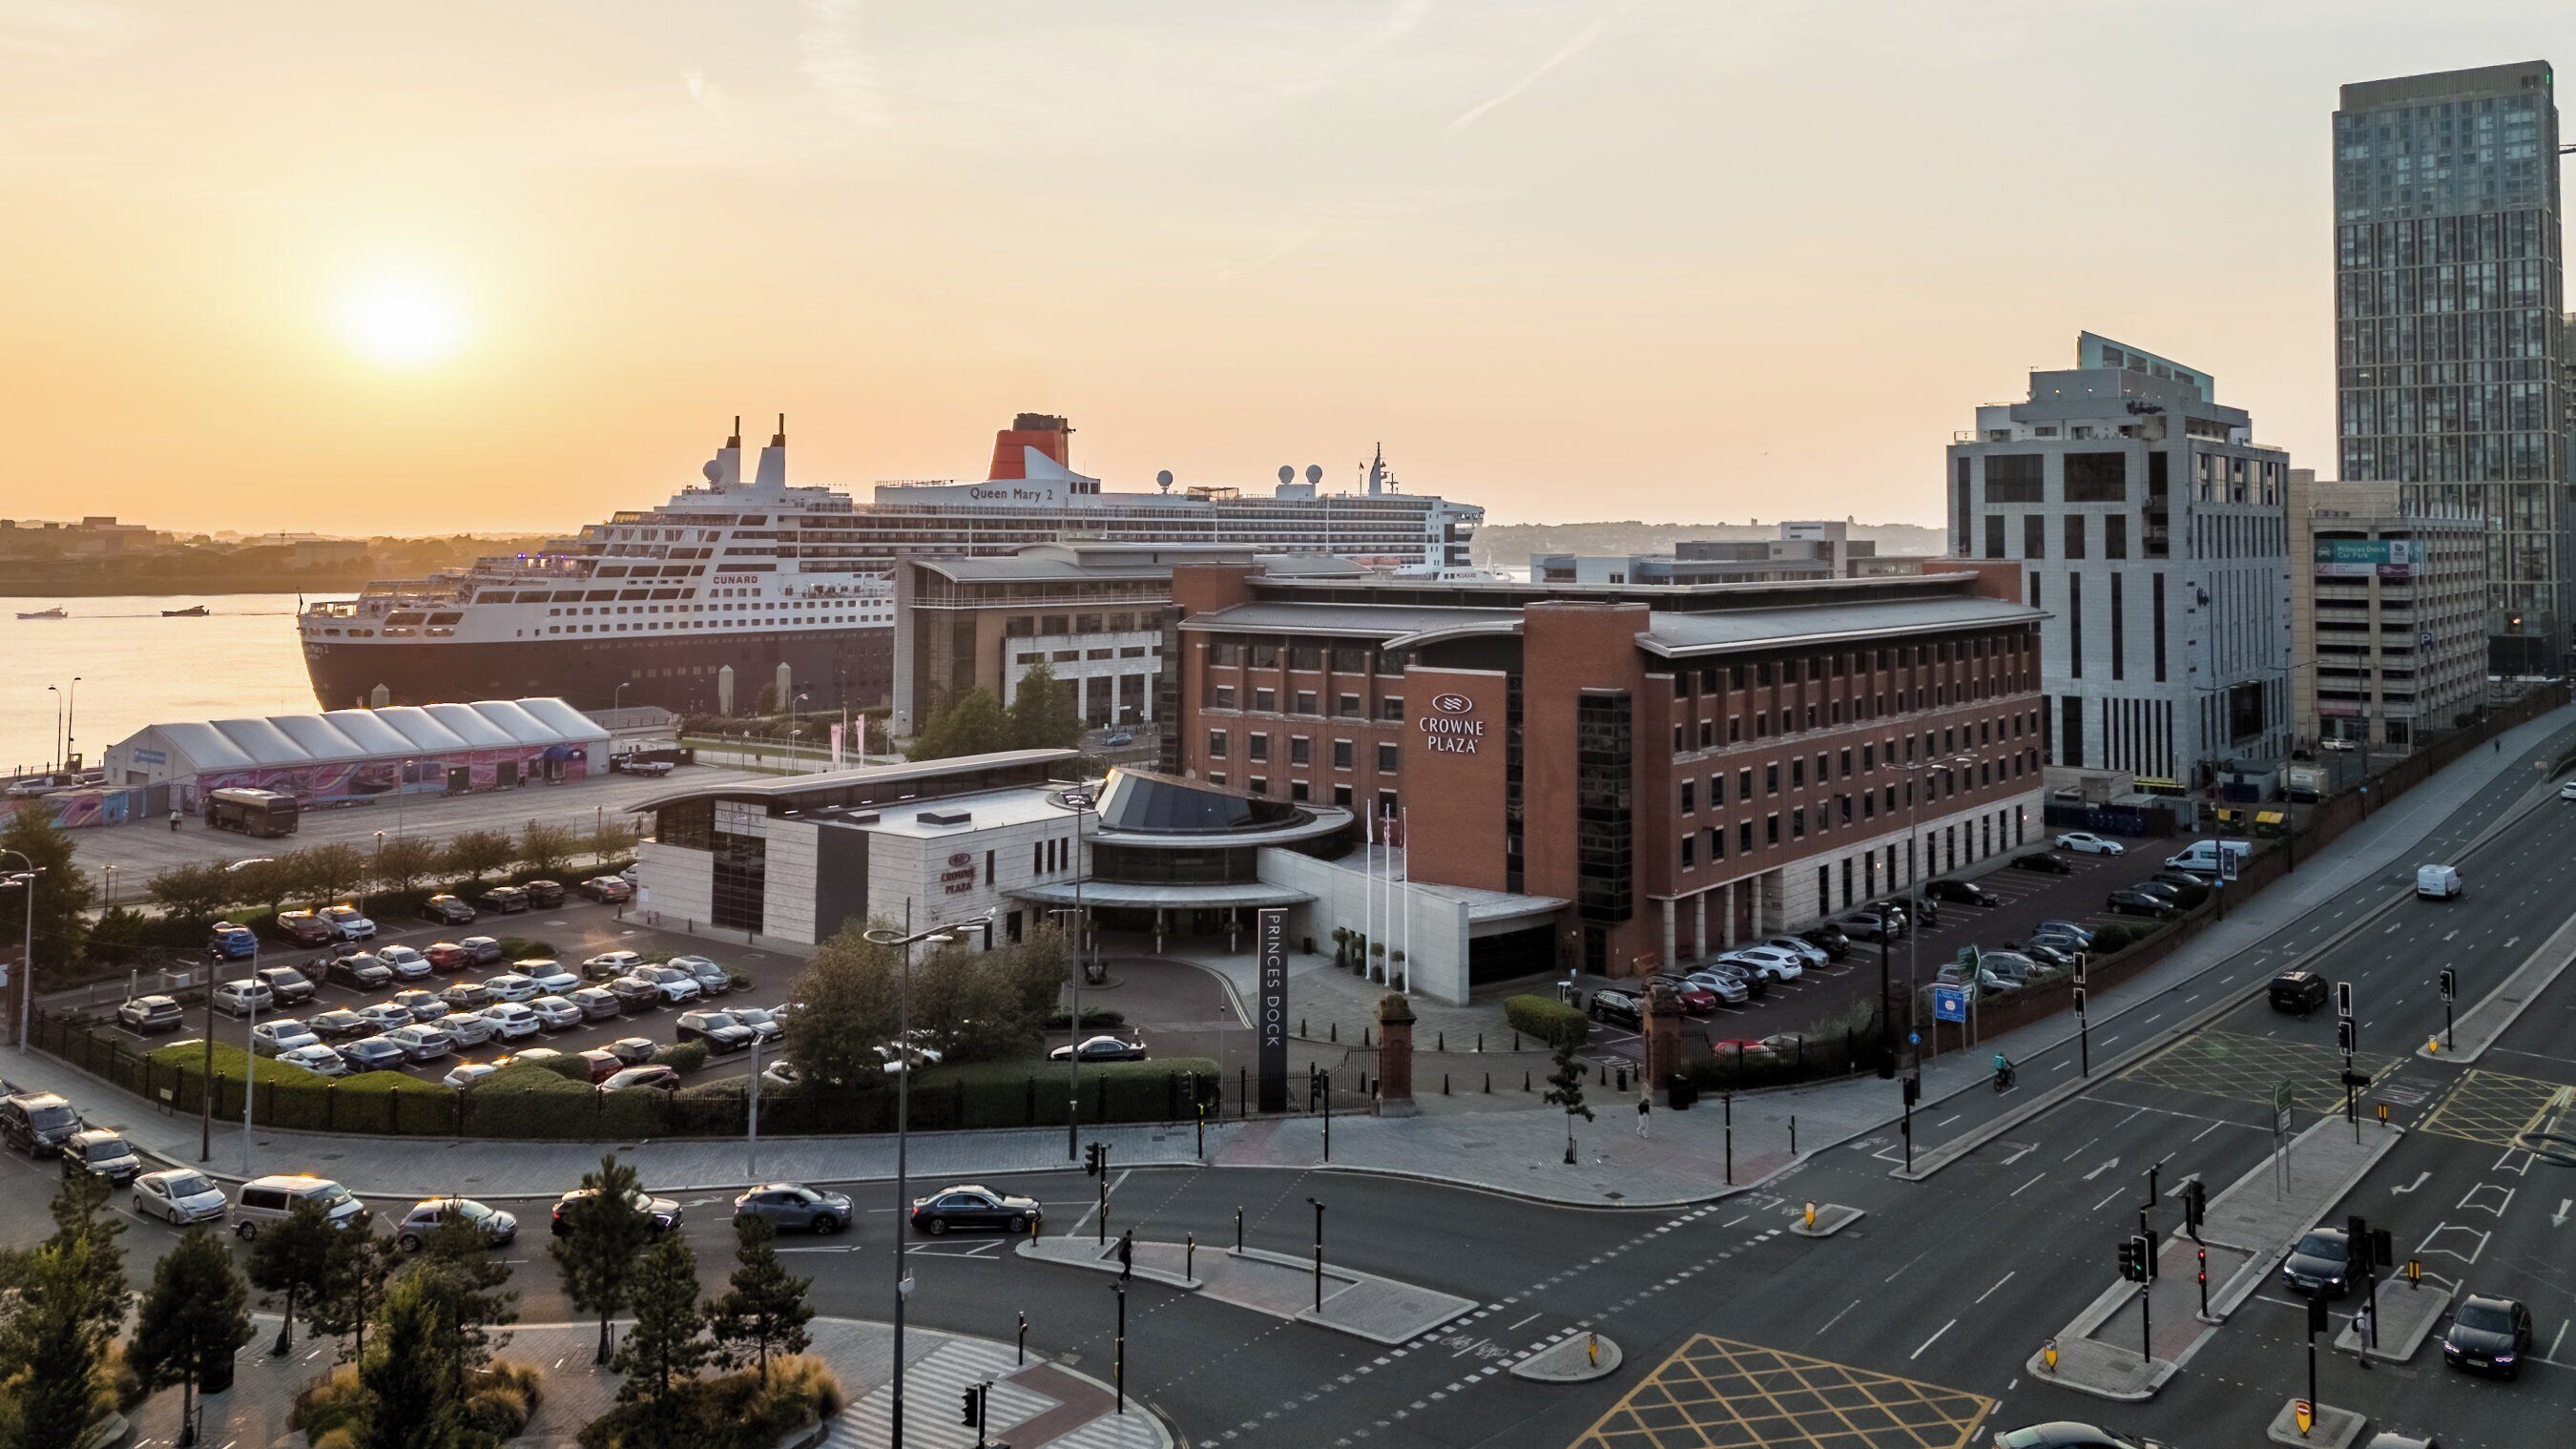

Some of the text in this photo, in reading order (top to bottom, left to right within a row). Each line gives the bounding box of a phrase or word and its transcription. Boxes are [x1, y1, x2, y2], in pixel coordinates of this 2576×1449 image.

[970, 486, 1053, 503] Queen Mary 2
[2420, 633, 2431, 644] P
[1420, 716, 1484, 735] CROWNE
[1427, 735, 1476, 754] PLAZA
[941, 865, 976, 882] CROWNE
[945, 881, 972, 894] PLAZA
[1267, 915, 1280, 1046] PRINCES DOCK
